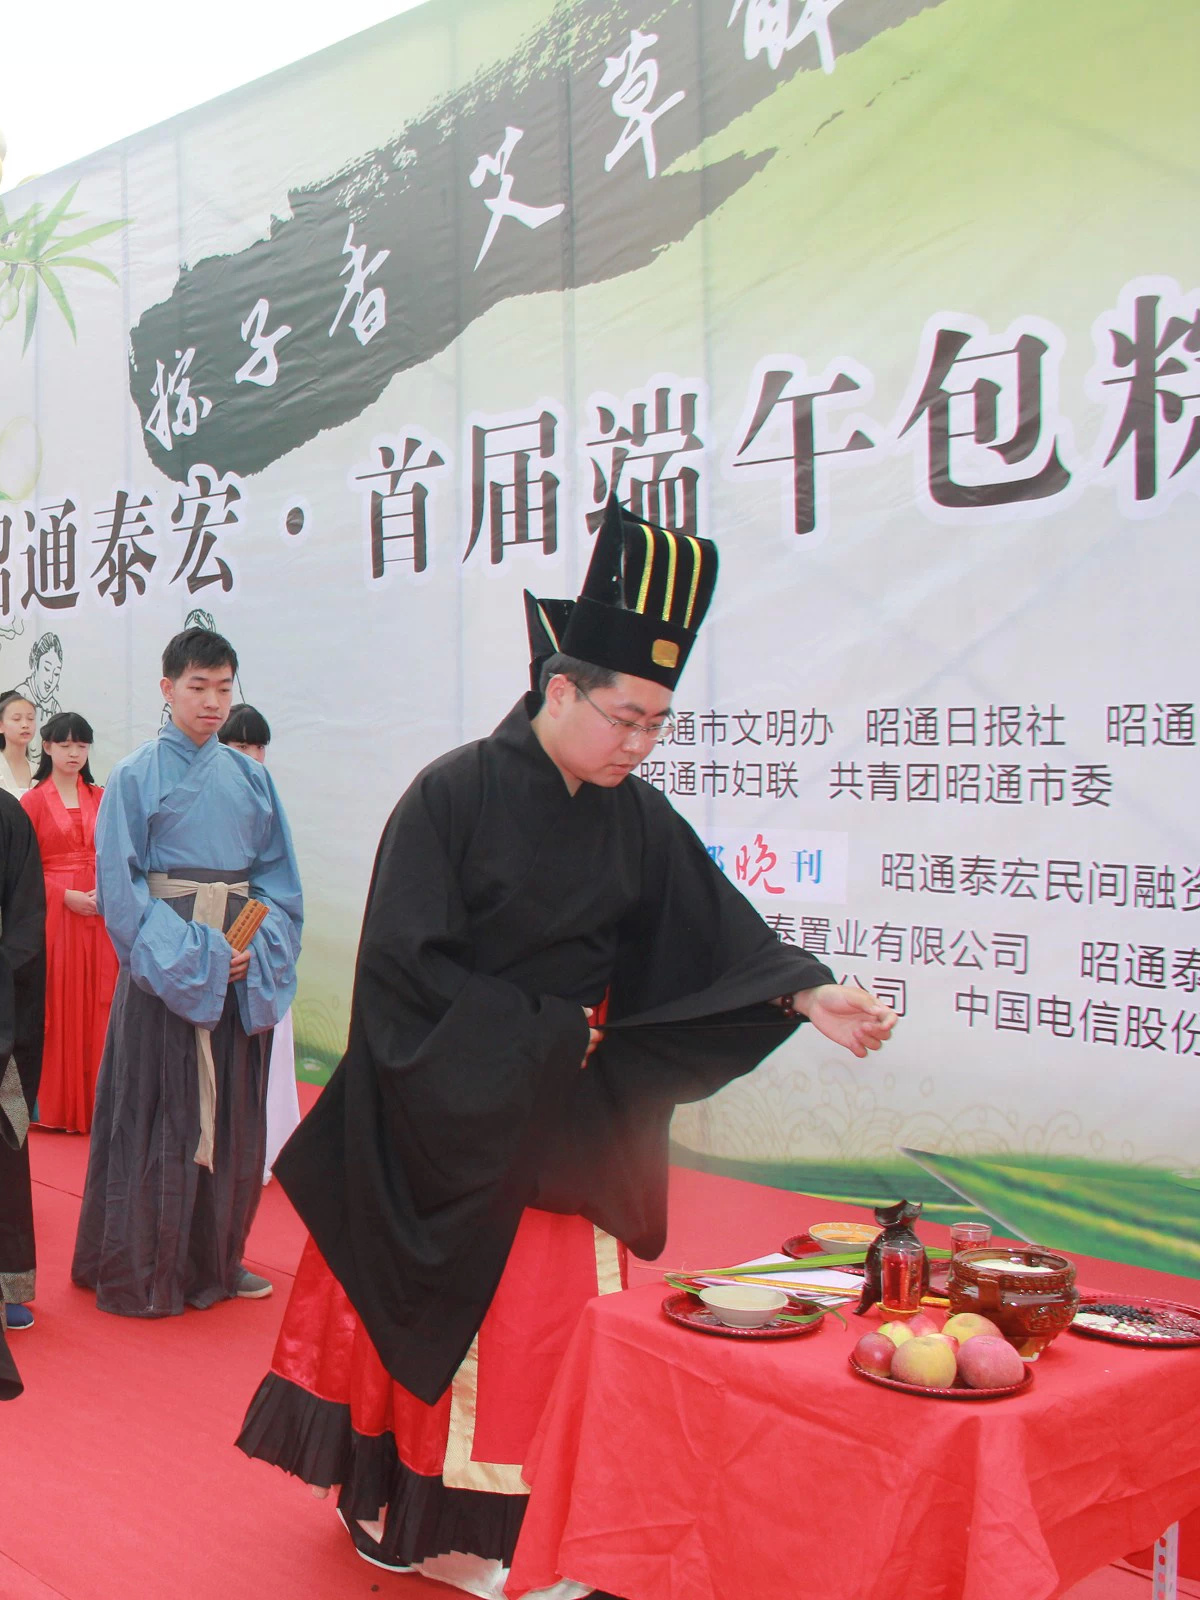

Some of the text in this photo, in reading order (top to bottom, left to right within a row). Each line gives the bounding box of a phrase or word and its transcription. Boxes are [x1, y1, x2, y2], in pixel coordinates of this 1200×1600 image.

[656, 702, 1196, 748] 通市文明办 昭通日报社 昭通
[640, 759, 1114, 808] 昭通市妇联 共青团昭通市委
[765, 912, 1200, 993] 泰置业有限公司 昭通泰
[954, 984, 1200, 1057] 中国电信股份
